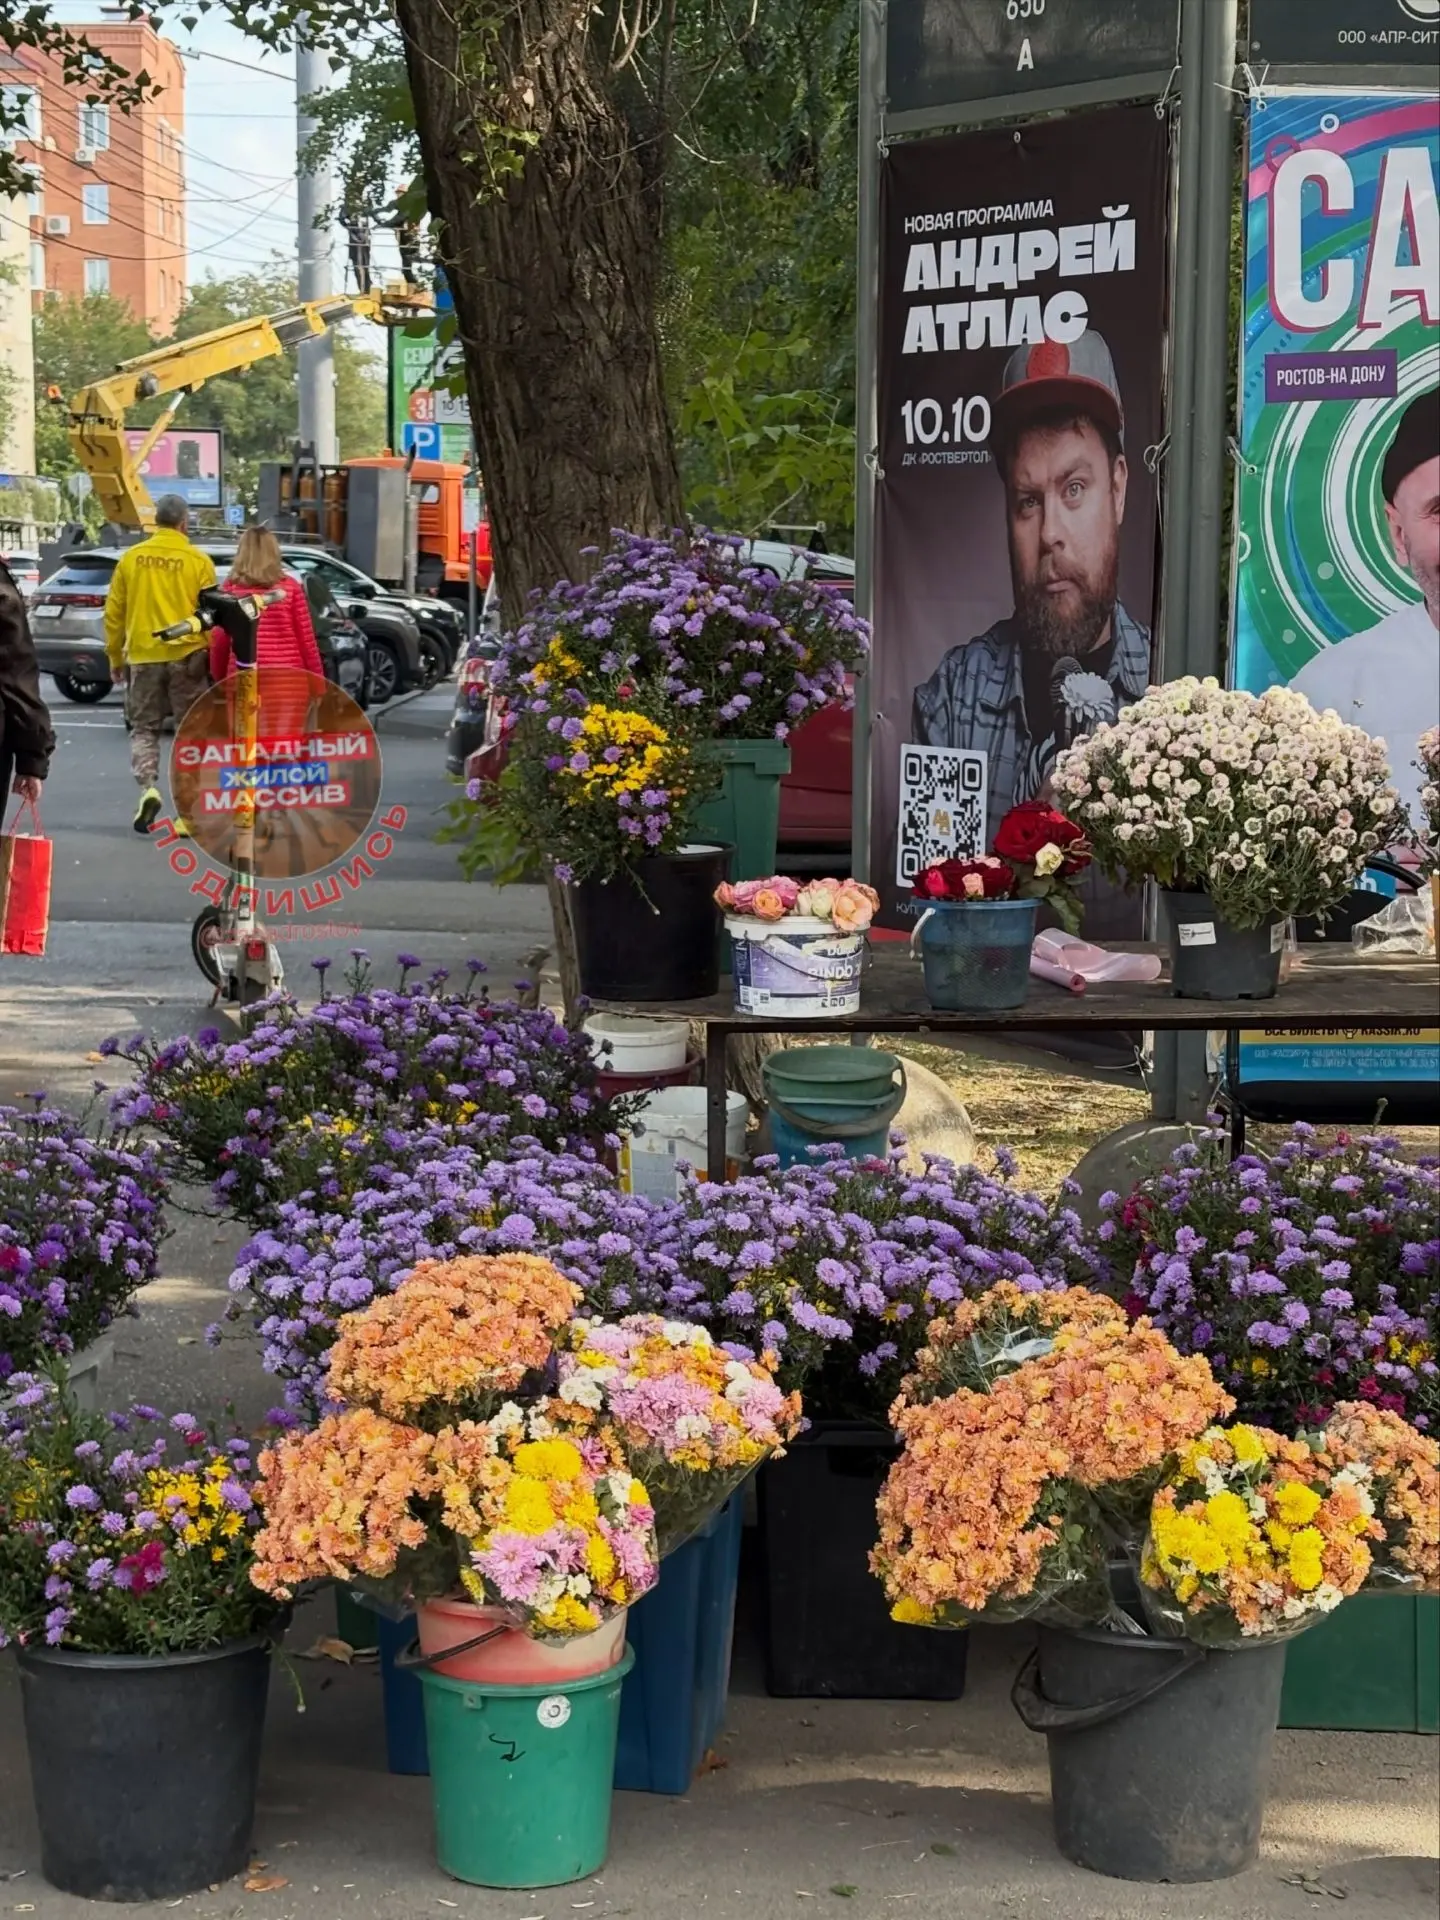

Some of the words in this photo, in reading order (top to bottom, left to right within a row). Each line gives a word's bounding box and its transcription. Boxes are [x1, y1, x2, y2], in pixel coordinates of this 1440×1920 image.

[1338, 30, 1366, 44] ООО
[1016, 38, 1034, 71] А
[904, 212, 954, 234] НОВАЯ
[957, 199, 1054, 228] ПРОГРАММА
[903, 204, 1136, 292] АНДРЕЙ
[1269, 147, 1439, 332] СА
[902, 290, 1088, 354] АТЛАС
[1277, 366, 1347, 386] РОСТОВ-НА
[1350, 365, 1386, 384] ДОНУ
[901, 395, 991, 444] 10.10
[412, 427, 435, 460] P
[902, 453, 917, 467] ДК
